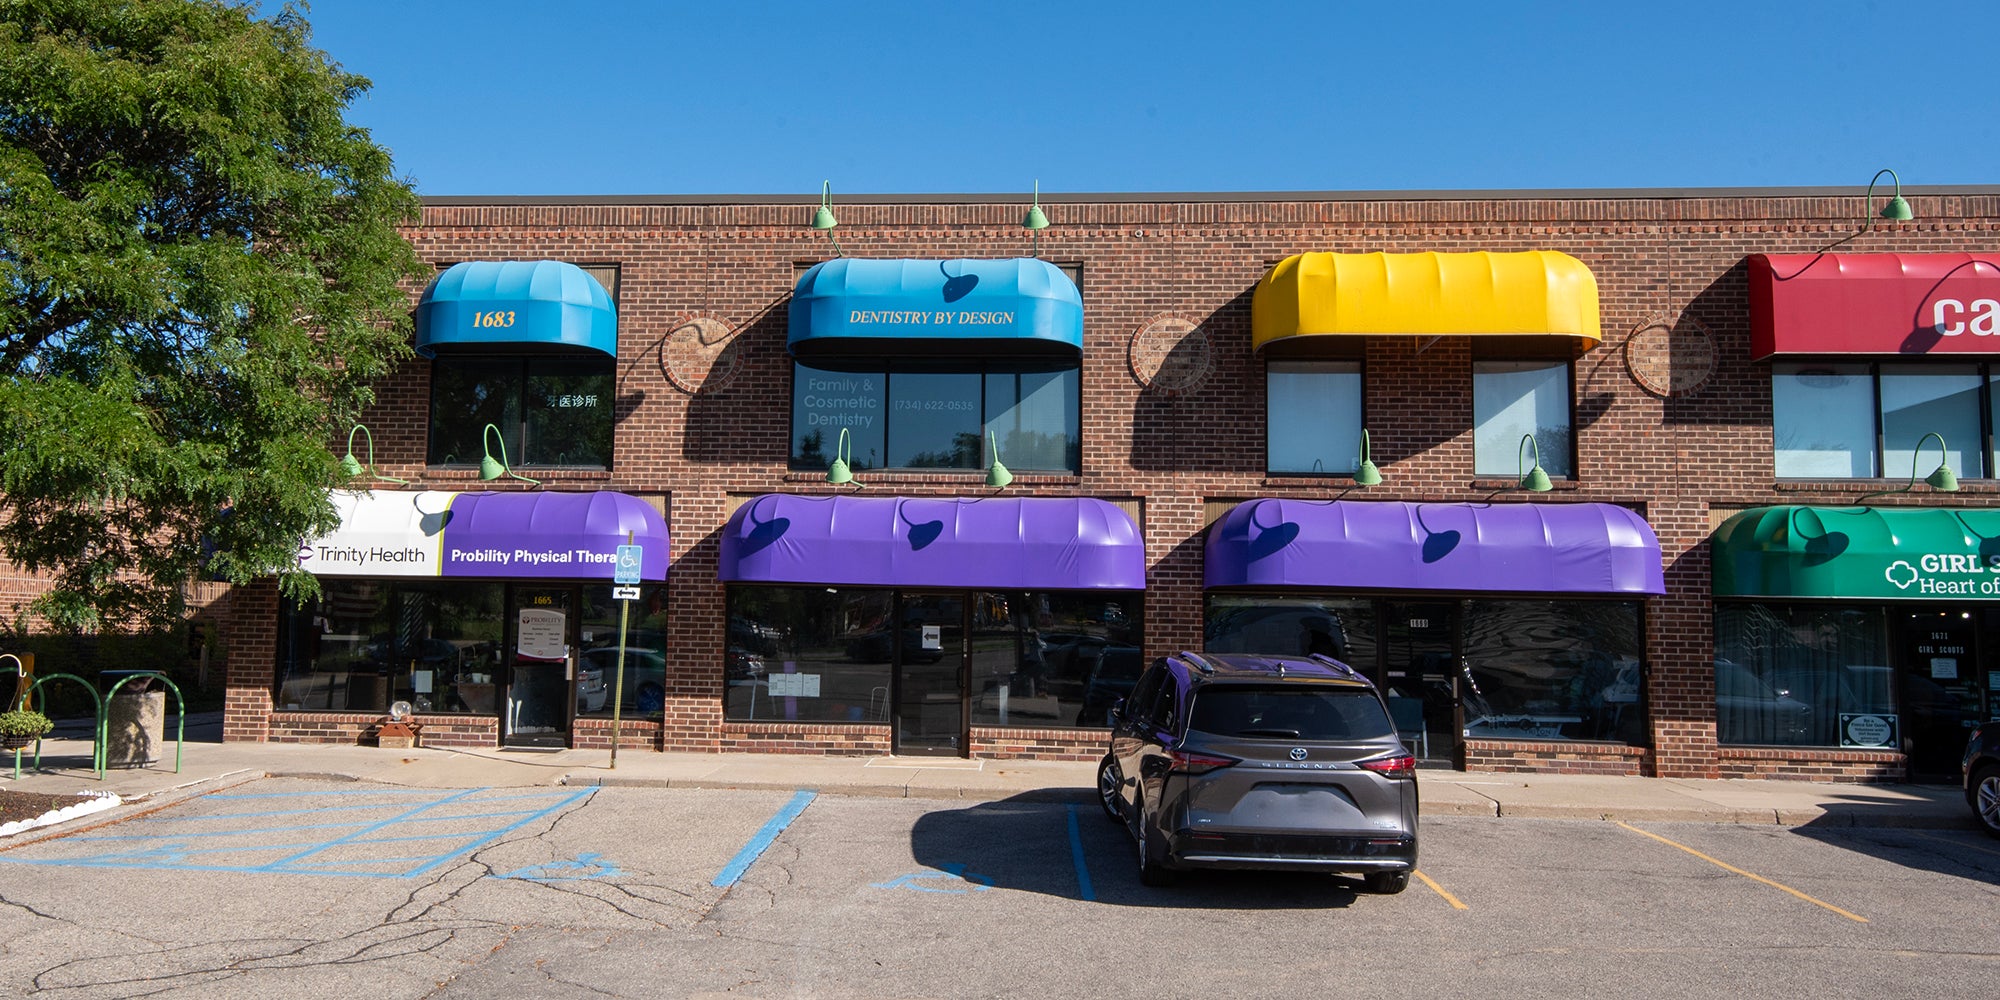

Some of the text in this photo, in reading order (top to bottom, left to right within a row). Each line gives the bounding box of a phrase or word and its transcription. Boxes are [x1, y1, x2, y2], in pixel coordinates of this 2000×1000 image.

[472, 311, 516, 328] 1683
[849, 310, 1015, 325] DENTISTRY BY DESIGN
[1933, 298, 2000, 337] ca
[808, 378, 874, 394] Family &
[547, 395, 598, 408] 牙医诊所
[803, 395, 877, 409] Cosmetic
[894, 400, 974, 412] (734) 622-0535
[808, 412, 873, 428] Dentistry
[317, 546, 425, 566] Trinity Health
[451, 549, 617, 565] Probility Physical Thera
[1920, 553, 1984, 573] GIRL
[1919, 577, 2000, 594] Heart of
[533, 596, 553, 605] 1665
[1931, 632, 1948, 640] 1671
[1918, 646, 1965, 654] GIRL SCOUTS
